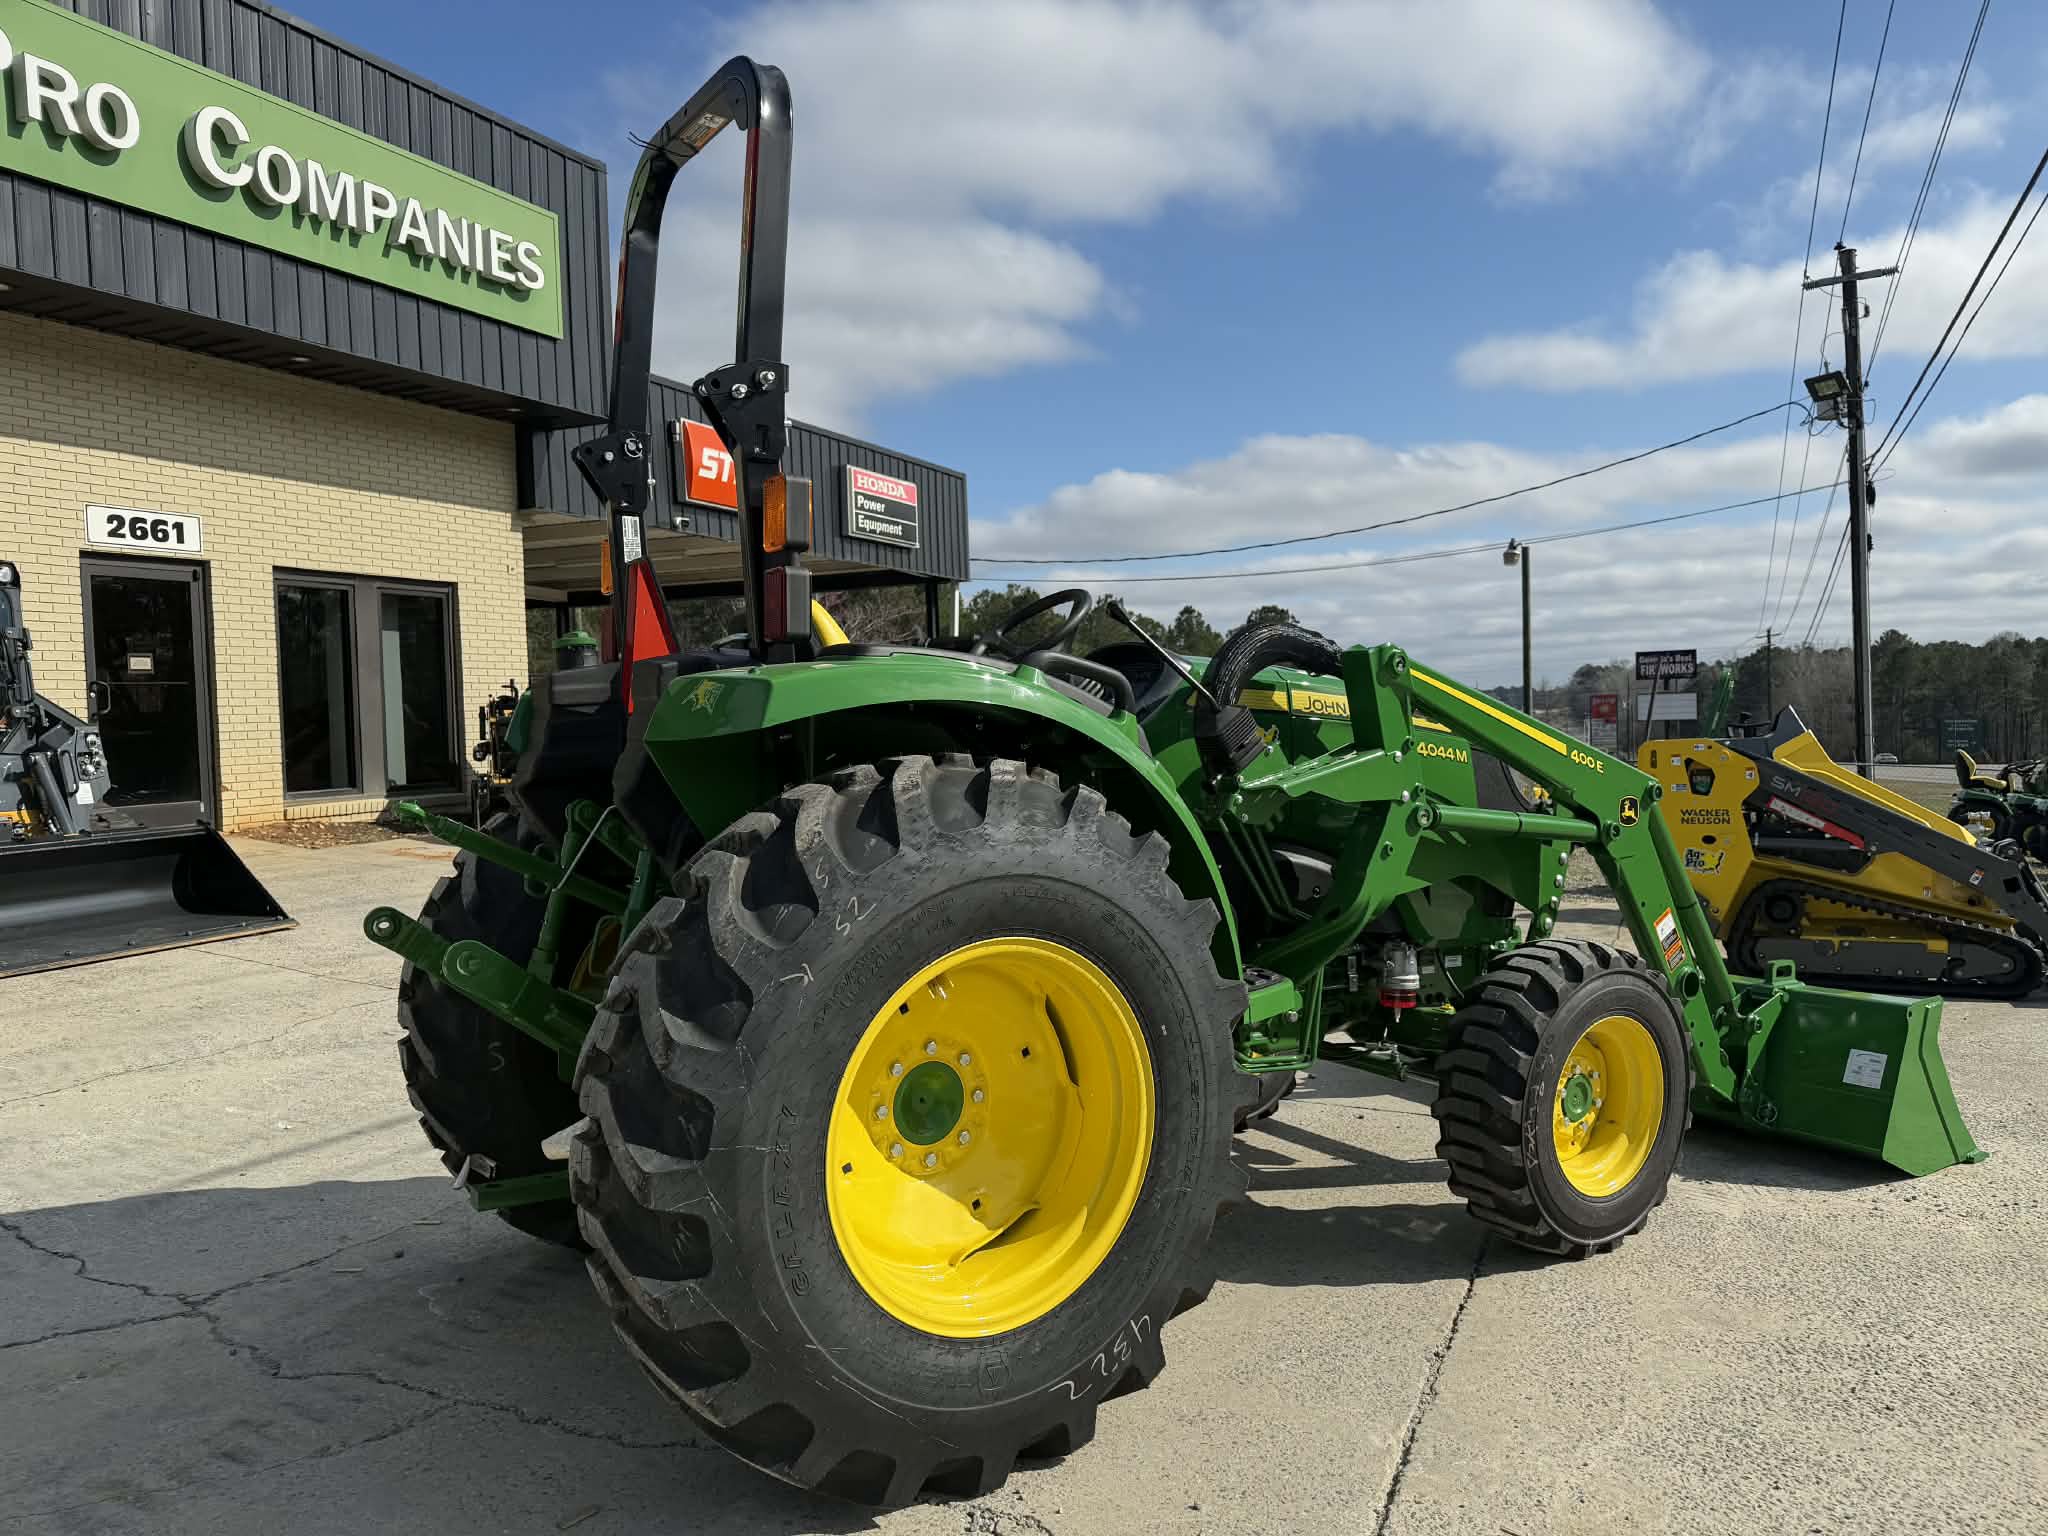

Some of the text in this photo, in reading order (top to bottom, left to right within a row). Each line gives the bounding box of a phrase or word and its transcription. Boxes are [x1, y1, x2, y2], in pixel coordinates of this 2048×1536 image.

[184, 106, 545, 291] COMPANIES
[698, 447, 736, 485] ST
[857, 473, 907, 498] HONDA
[857, 495, 886, 513] Power
[106, 514, 186, 544] 2661
[858, 517, 903, 536] Equipment
[1303, 695, 1347, 715] JOHN
[1680, 808, 1730, 816] WACKER
[1681, 816, 1731, 824] NEUSON
